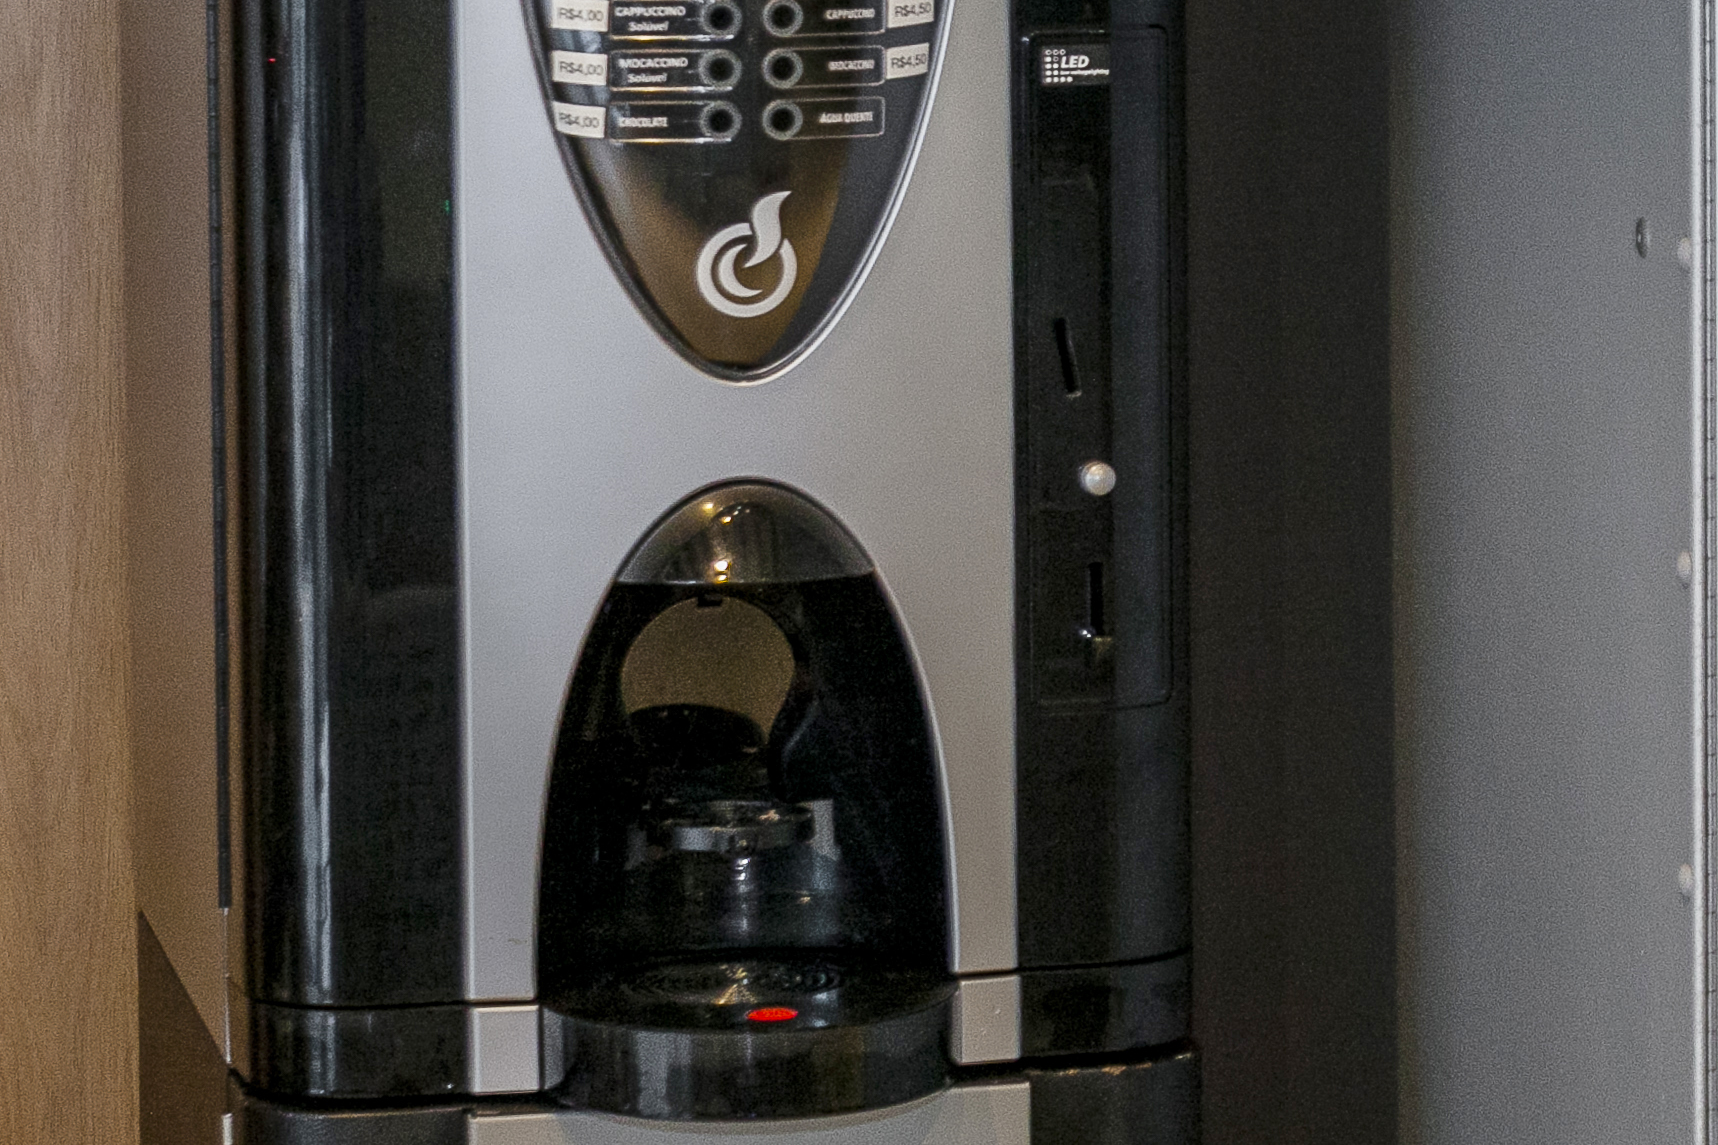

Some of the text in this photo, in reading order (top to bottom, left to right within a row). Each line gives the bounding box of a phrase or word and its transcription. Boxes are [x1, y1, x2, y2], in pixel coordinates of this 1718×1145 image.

[558, 7, 605, 22] R$4,00
[894, 2, 933, 18] R$4,50
[558, 60, 605, 75] R$4,00
[890, 52, 928, 68] R$4,50
[1060, 54, 1091, 69] LED
[557, 111, 601, 128] R$4,00
